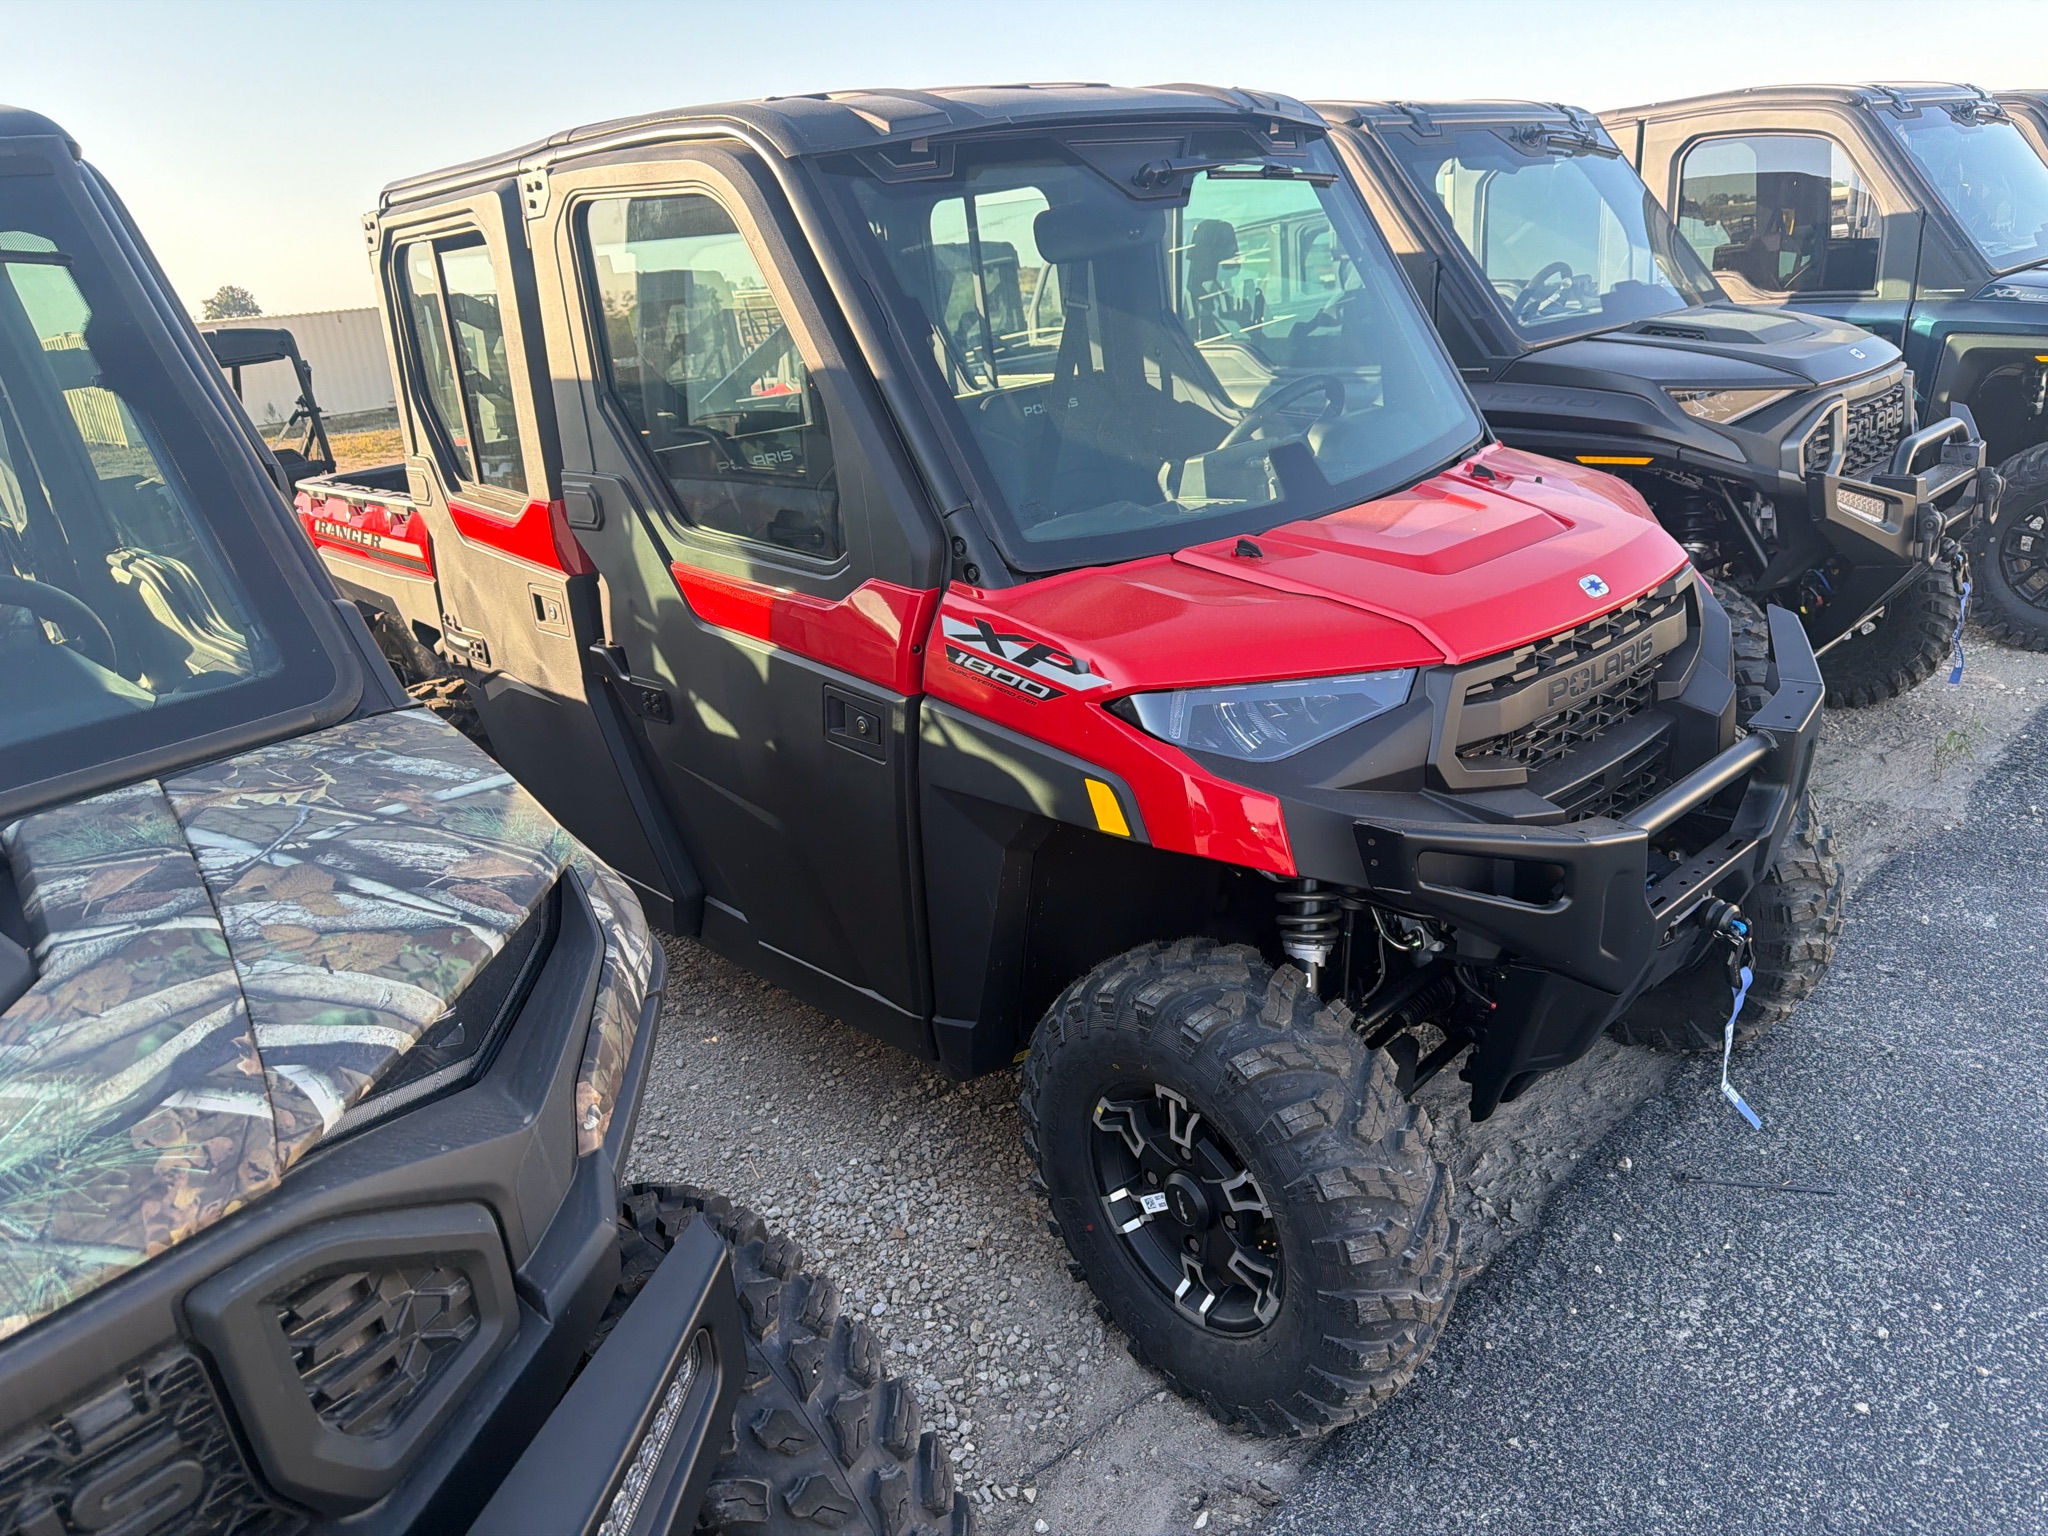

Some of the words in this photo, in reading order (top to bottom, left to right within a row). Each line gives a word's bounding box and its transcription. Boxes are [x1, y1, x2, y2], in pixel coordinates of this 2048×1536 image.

[317, 519, 382, 549] RANGER
[948, 617, 1092, 675] XP
[948, 666, 969, 678] DUAL
[971, 675, 1016, 697] OVERHEAD
[1017, 694, 1038, 707] CAM
[954, 652, 1051, 699] 1000
[1547, 632, 1653, 709] POLARIS
